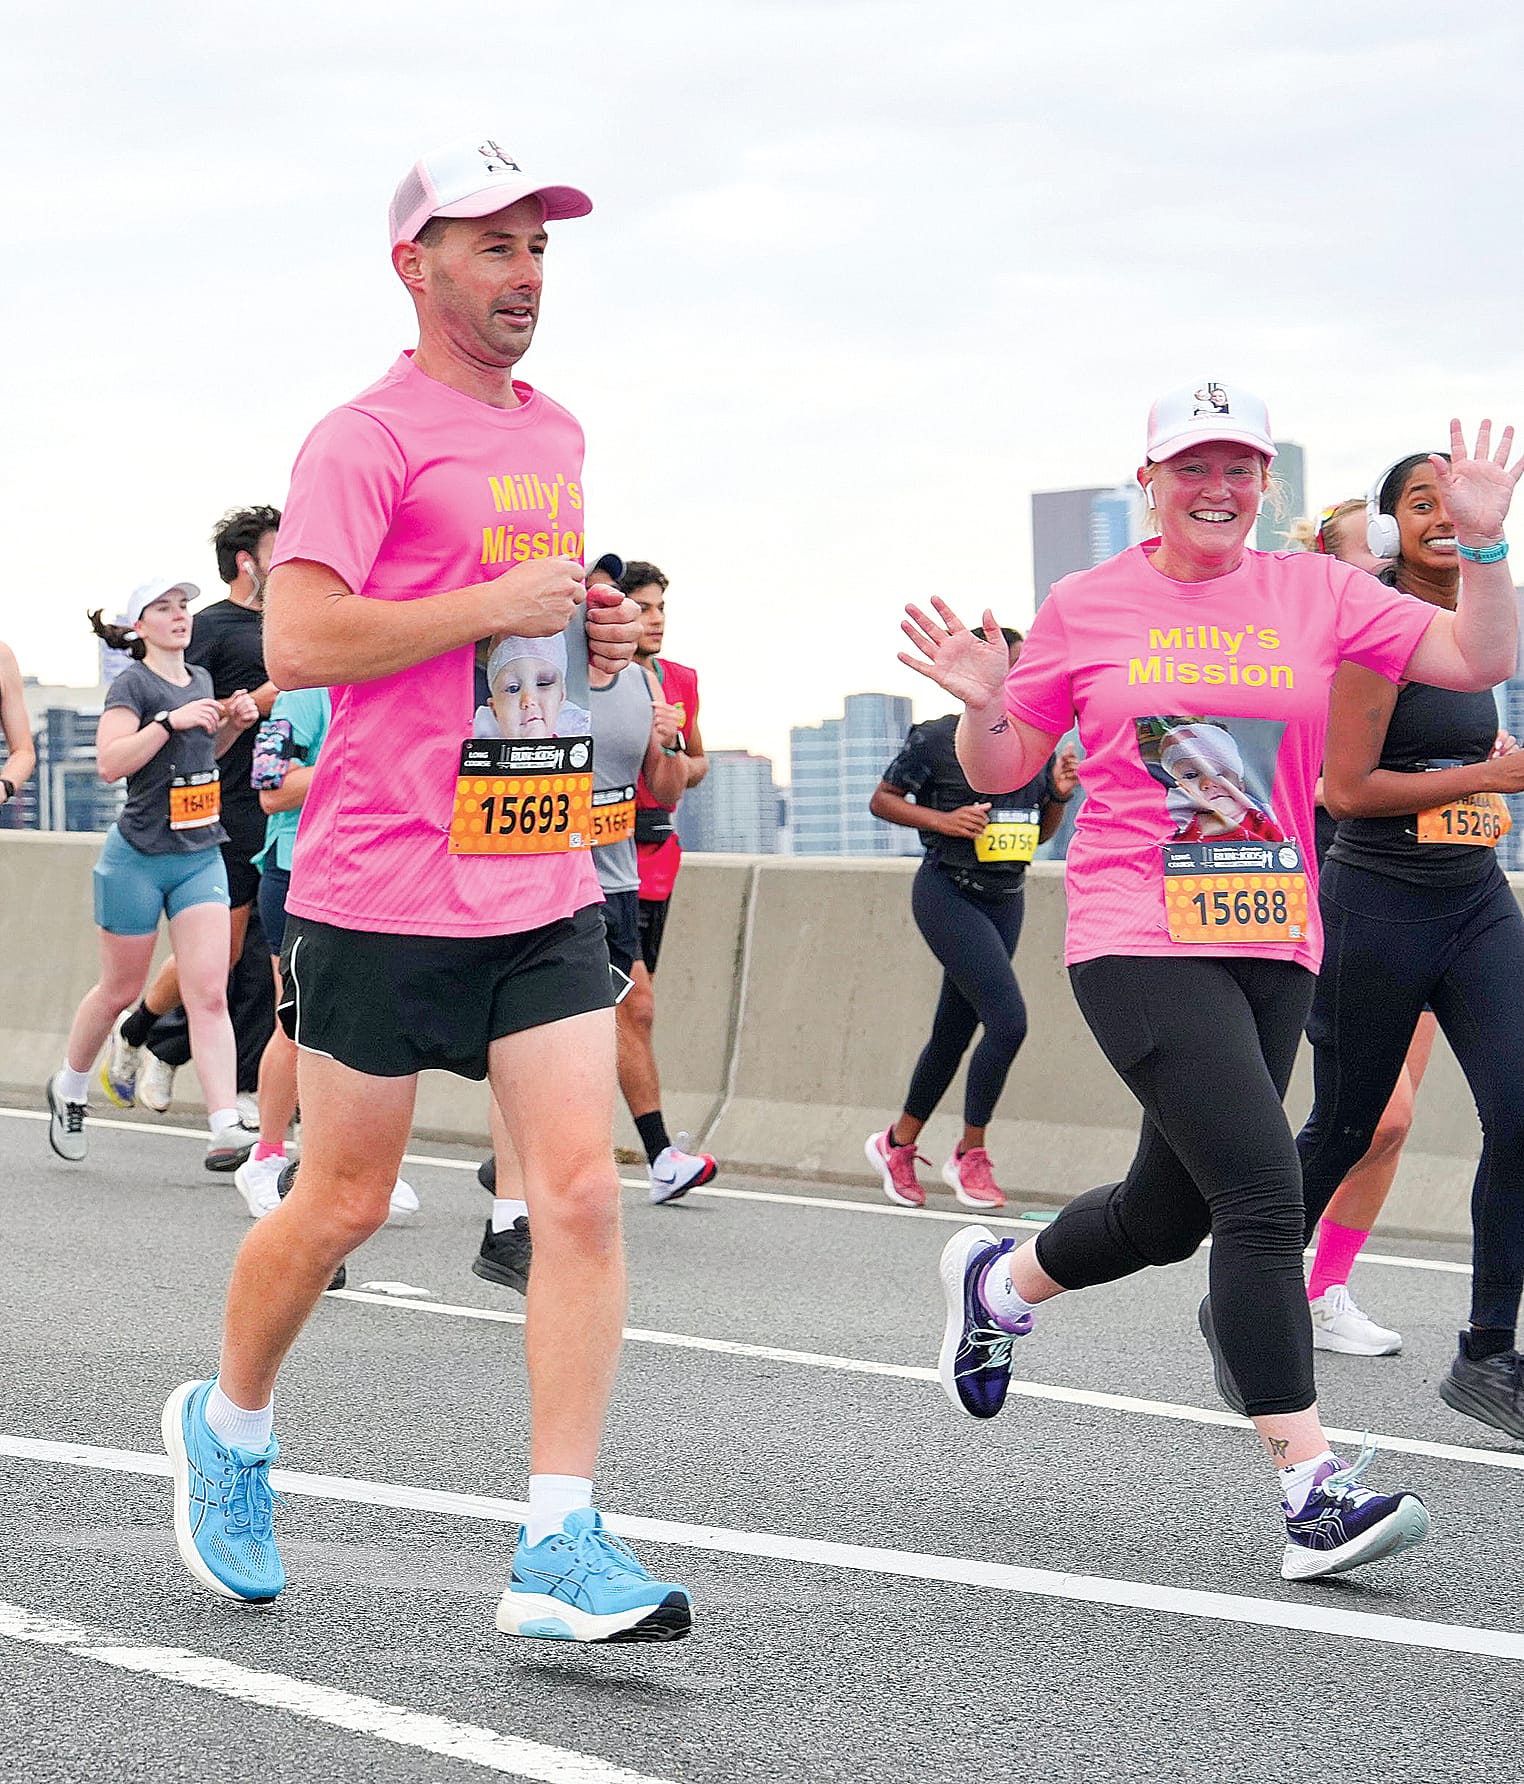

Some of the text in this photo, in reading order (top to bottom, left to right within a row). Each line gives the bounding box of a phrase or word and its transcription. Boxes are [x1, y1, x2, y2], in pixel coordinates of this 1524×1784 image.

[488, 473, 582, 519] Milly's
[1149, 624, 1281, 656] Milly's
[1128, 655, 1294, 689] Mission
[481, 794, 569, 835] 15693
[1440, 809, 1501, 839] 15266
[1192, 890, 1287, 925] 15688
